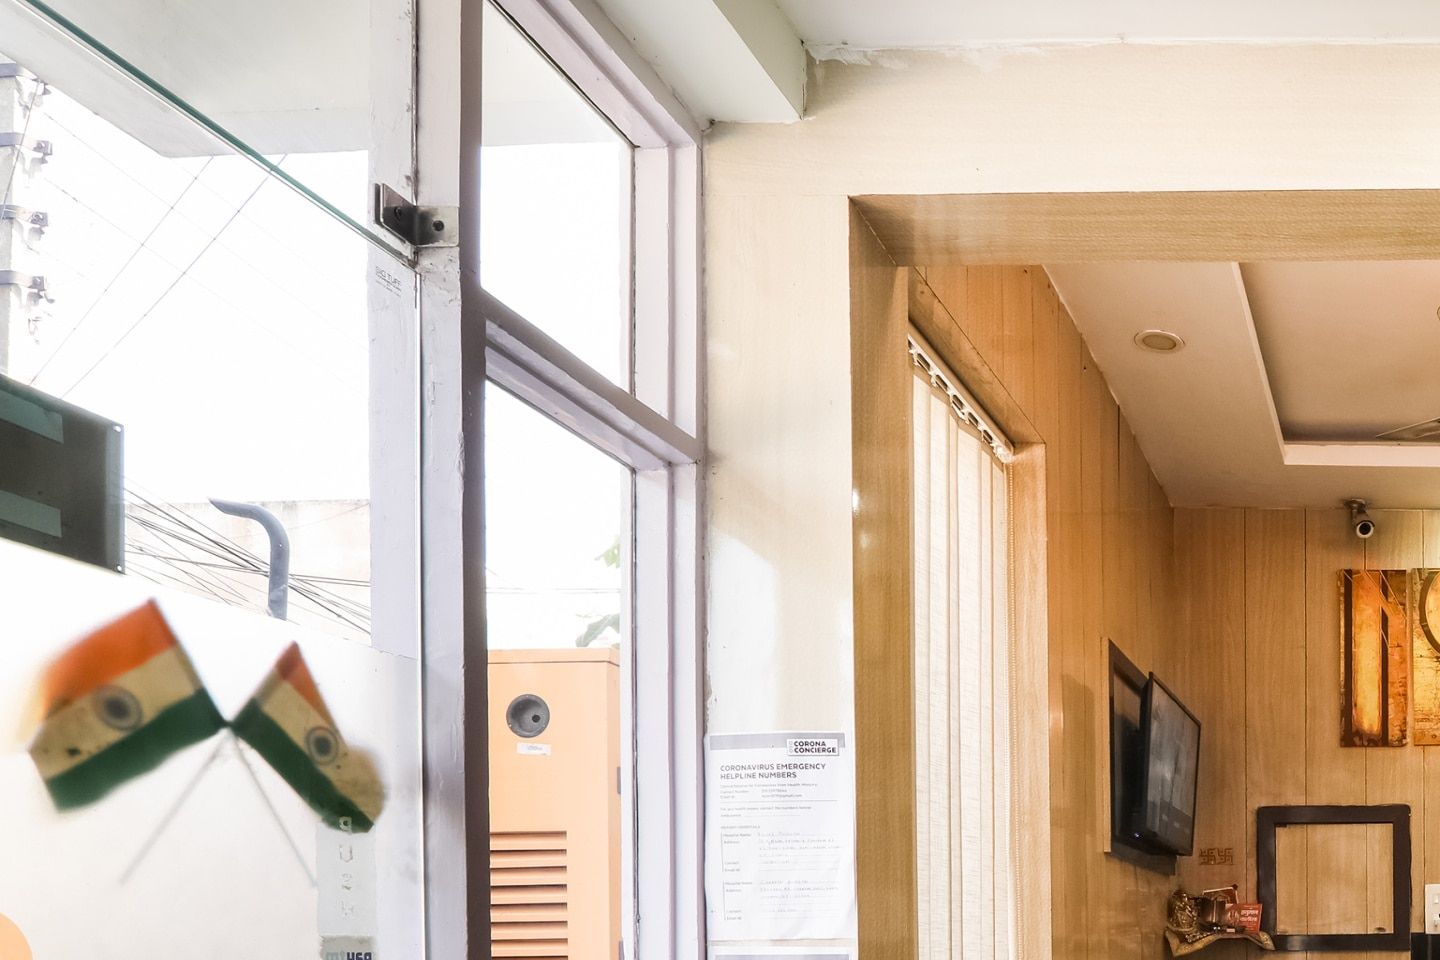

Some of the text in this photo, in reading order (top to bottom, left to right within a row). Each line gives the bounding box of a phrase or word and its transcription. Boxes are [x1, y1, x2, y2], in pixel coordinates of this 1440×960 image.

[720, 763, 826, 771] CORONAVIRUS EMERGENCY
[720, 771, 798, 780] HELPLINE NUMBERS
